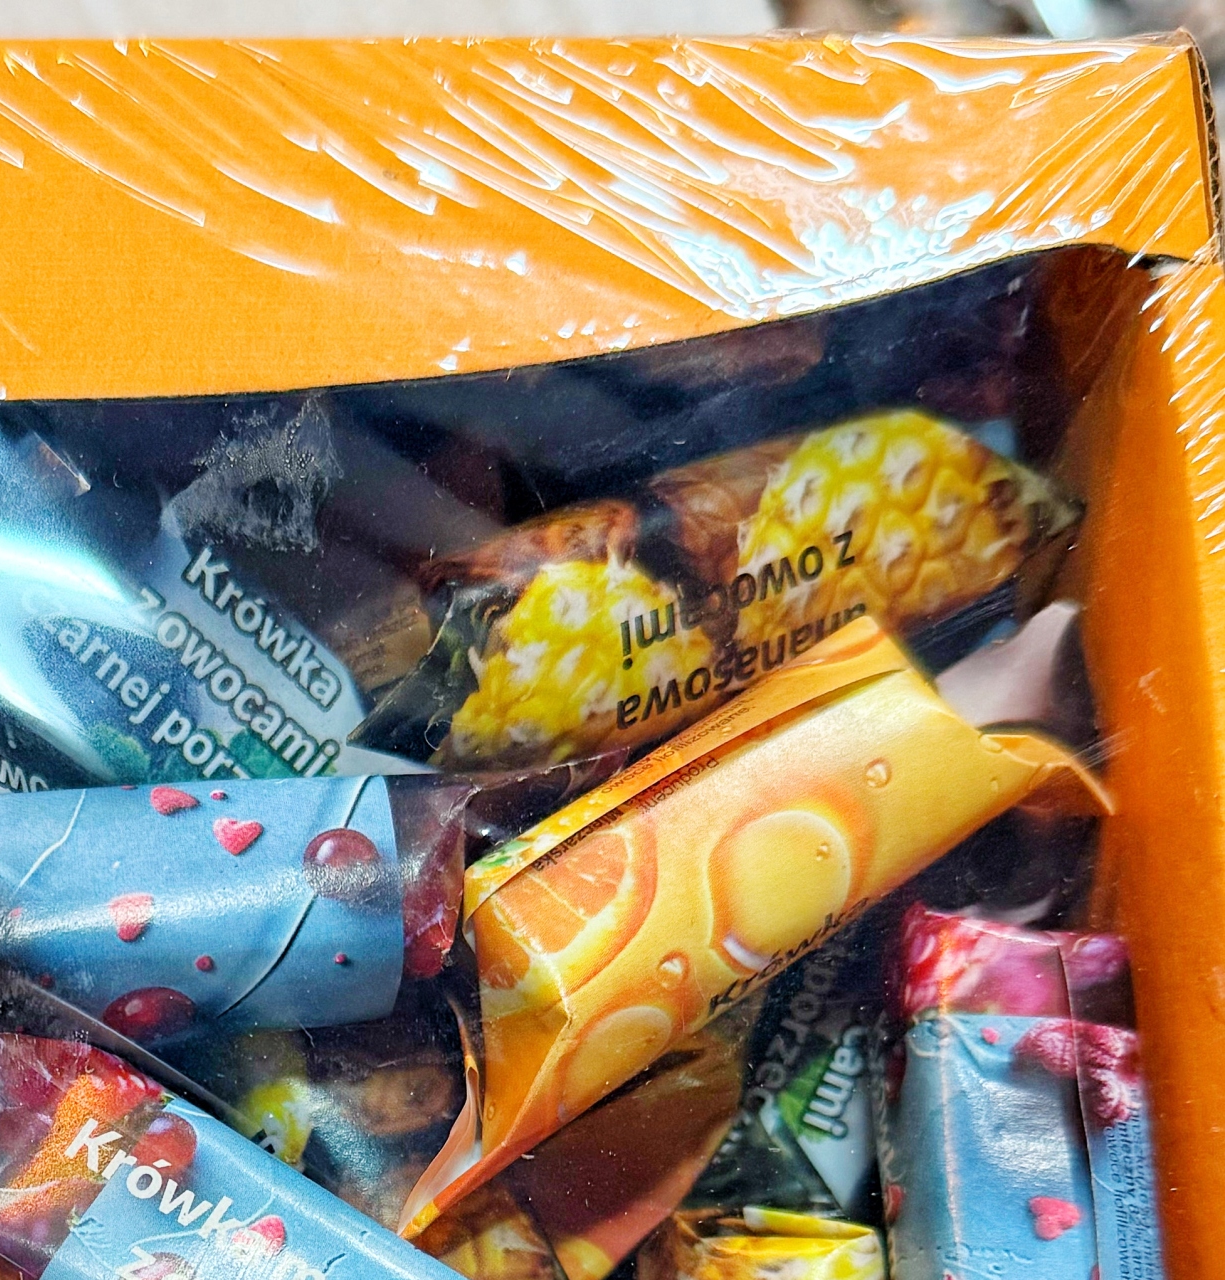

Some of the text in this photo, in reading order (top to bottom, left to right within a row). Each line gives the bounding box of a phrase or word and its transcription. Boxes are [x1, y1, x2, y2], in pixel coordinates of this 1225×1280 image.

[183, 546, 343, 713] Krówka
[619, 529, 857, 672] z owocami
[156, 609, 343, 778] owocami
